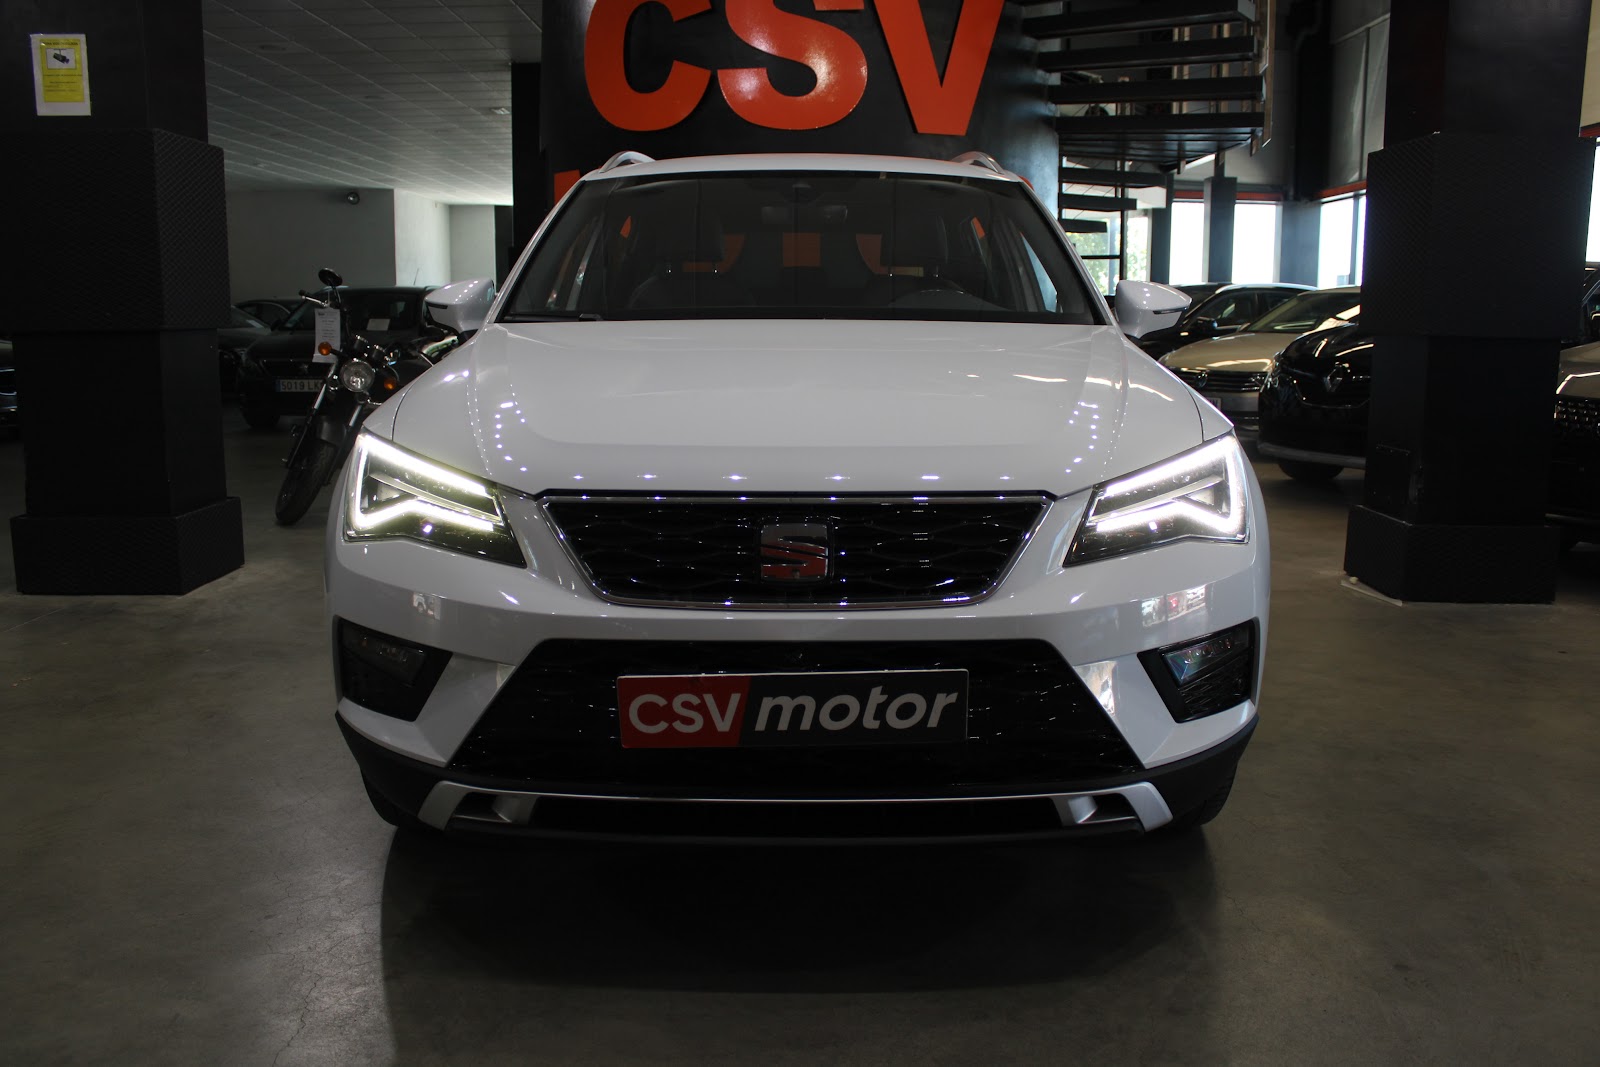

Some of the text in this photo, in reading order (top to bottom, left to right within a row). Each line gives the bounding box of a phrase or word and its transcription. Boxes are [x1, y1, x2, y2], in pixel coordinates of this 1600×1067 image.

[584, 0, 1003, 136] CSV
[281, 381, 305, 390] 5019
[629, 685, 958, 734] CSV motor
